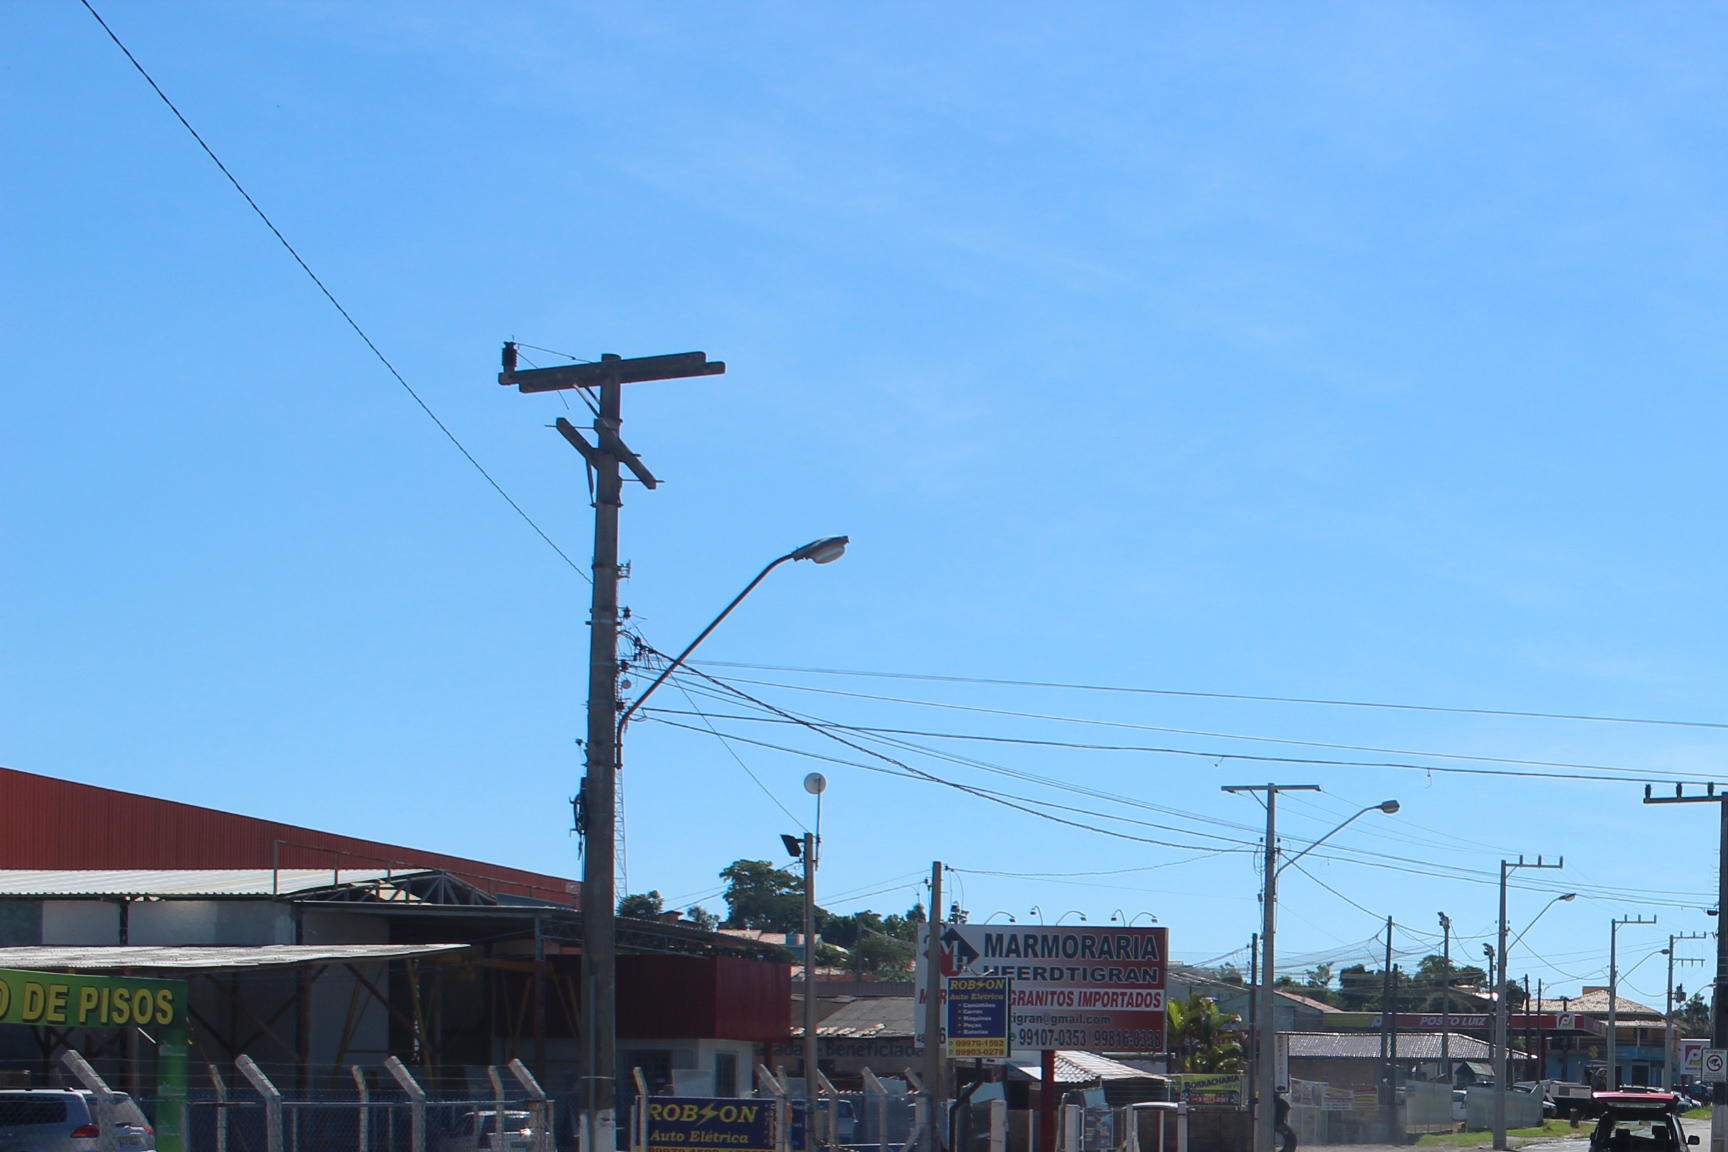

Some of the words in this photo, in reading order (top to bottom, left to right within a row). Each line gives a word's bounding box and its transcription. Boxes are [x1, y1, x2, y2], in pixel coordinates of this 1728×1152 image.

[984, 933, 1160, 962] MARMORARIA
[22, 981, 69, 1023] DE
[78, 986, 174, 1025] PISOS
[971, 992, 1004, 1000] Elétrica
[1011, 990, 1076, 1009] GRANITOS
[1078, 990, 1162, 1009] IMPORTADOS
[1420, 1016, 1459, 1026] POSO
[1462, 1016, 1486, 1026] LUIZ
[1019, 1028, 1087, 1047] 99107-0353
[826, 1041, 924, 1057] Beneficiada
[956, 1048, 1004, 1056] 99903-0278
[1184, 1075, 1240, 1090] BORRACHARIA
[650, 1130, 685, 1142] Auto
[689, 1130, 749, 1143] Elétrica
